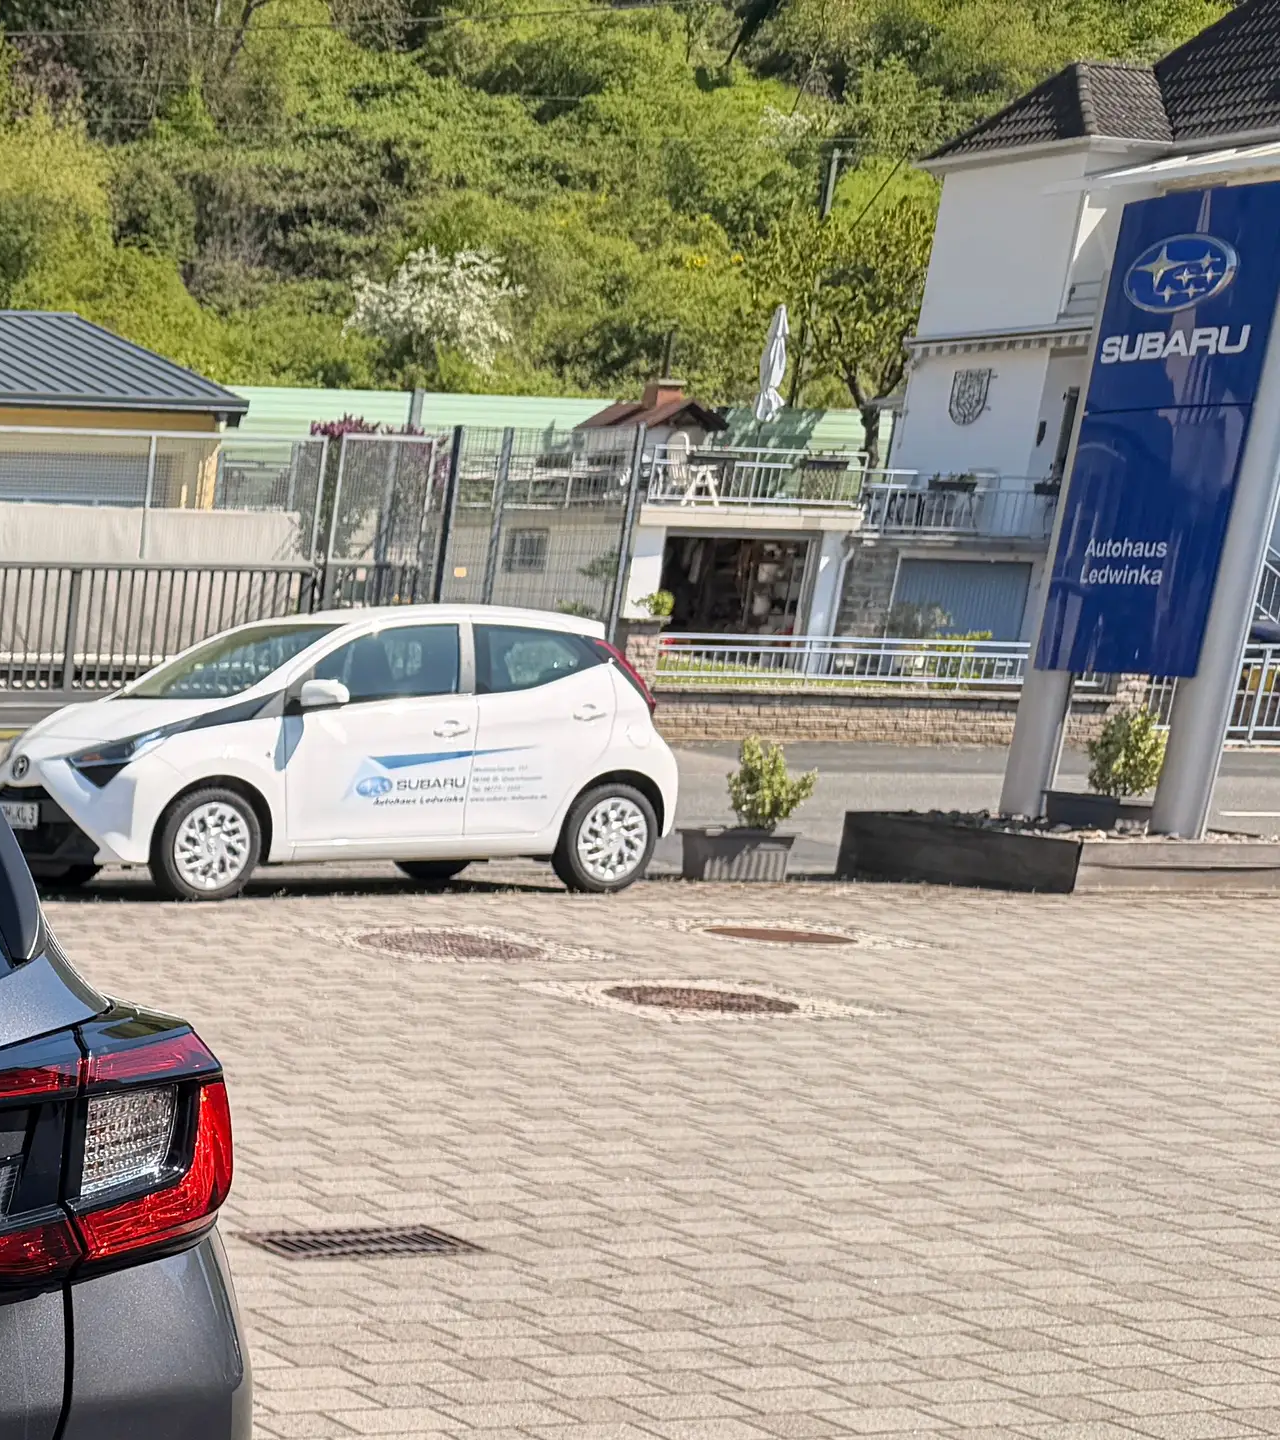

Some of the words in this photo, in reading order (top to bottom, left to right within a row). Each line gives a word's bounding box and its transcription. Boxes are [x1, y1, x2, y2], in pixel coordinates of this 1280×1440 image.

[1098, 324, 1252, 364] SUBARU
[1084, 537, 1168, 559] Autohaus
[1079, 563, 1163, 586] Ledwinka
[396, 775, 466, 791] SUBARU
